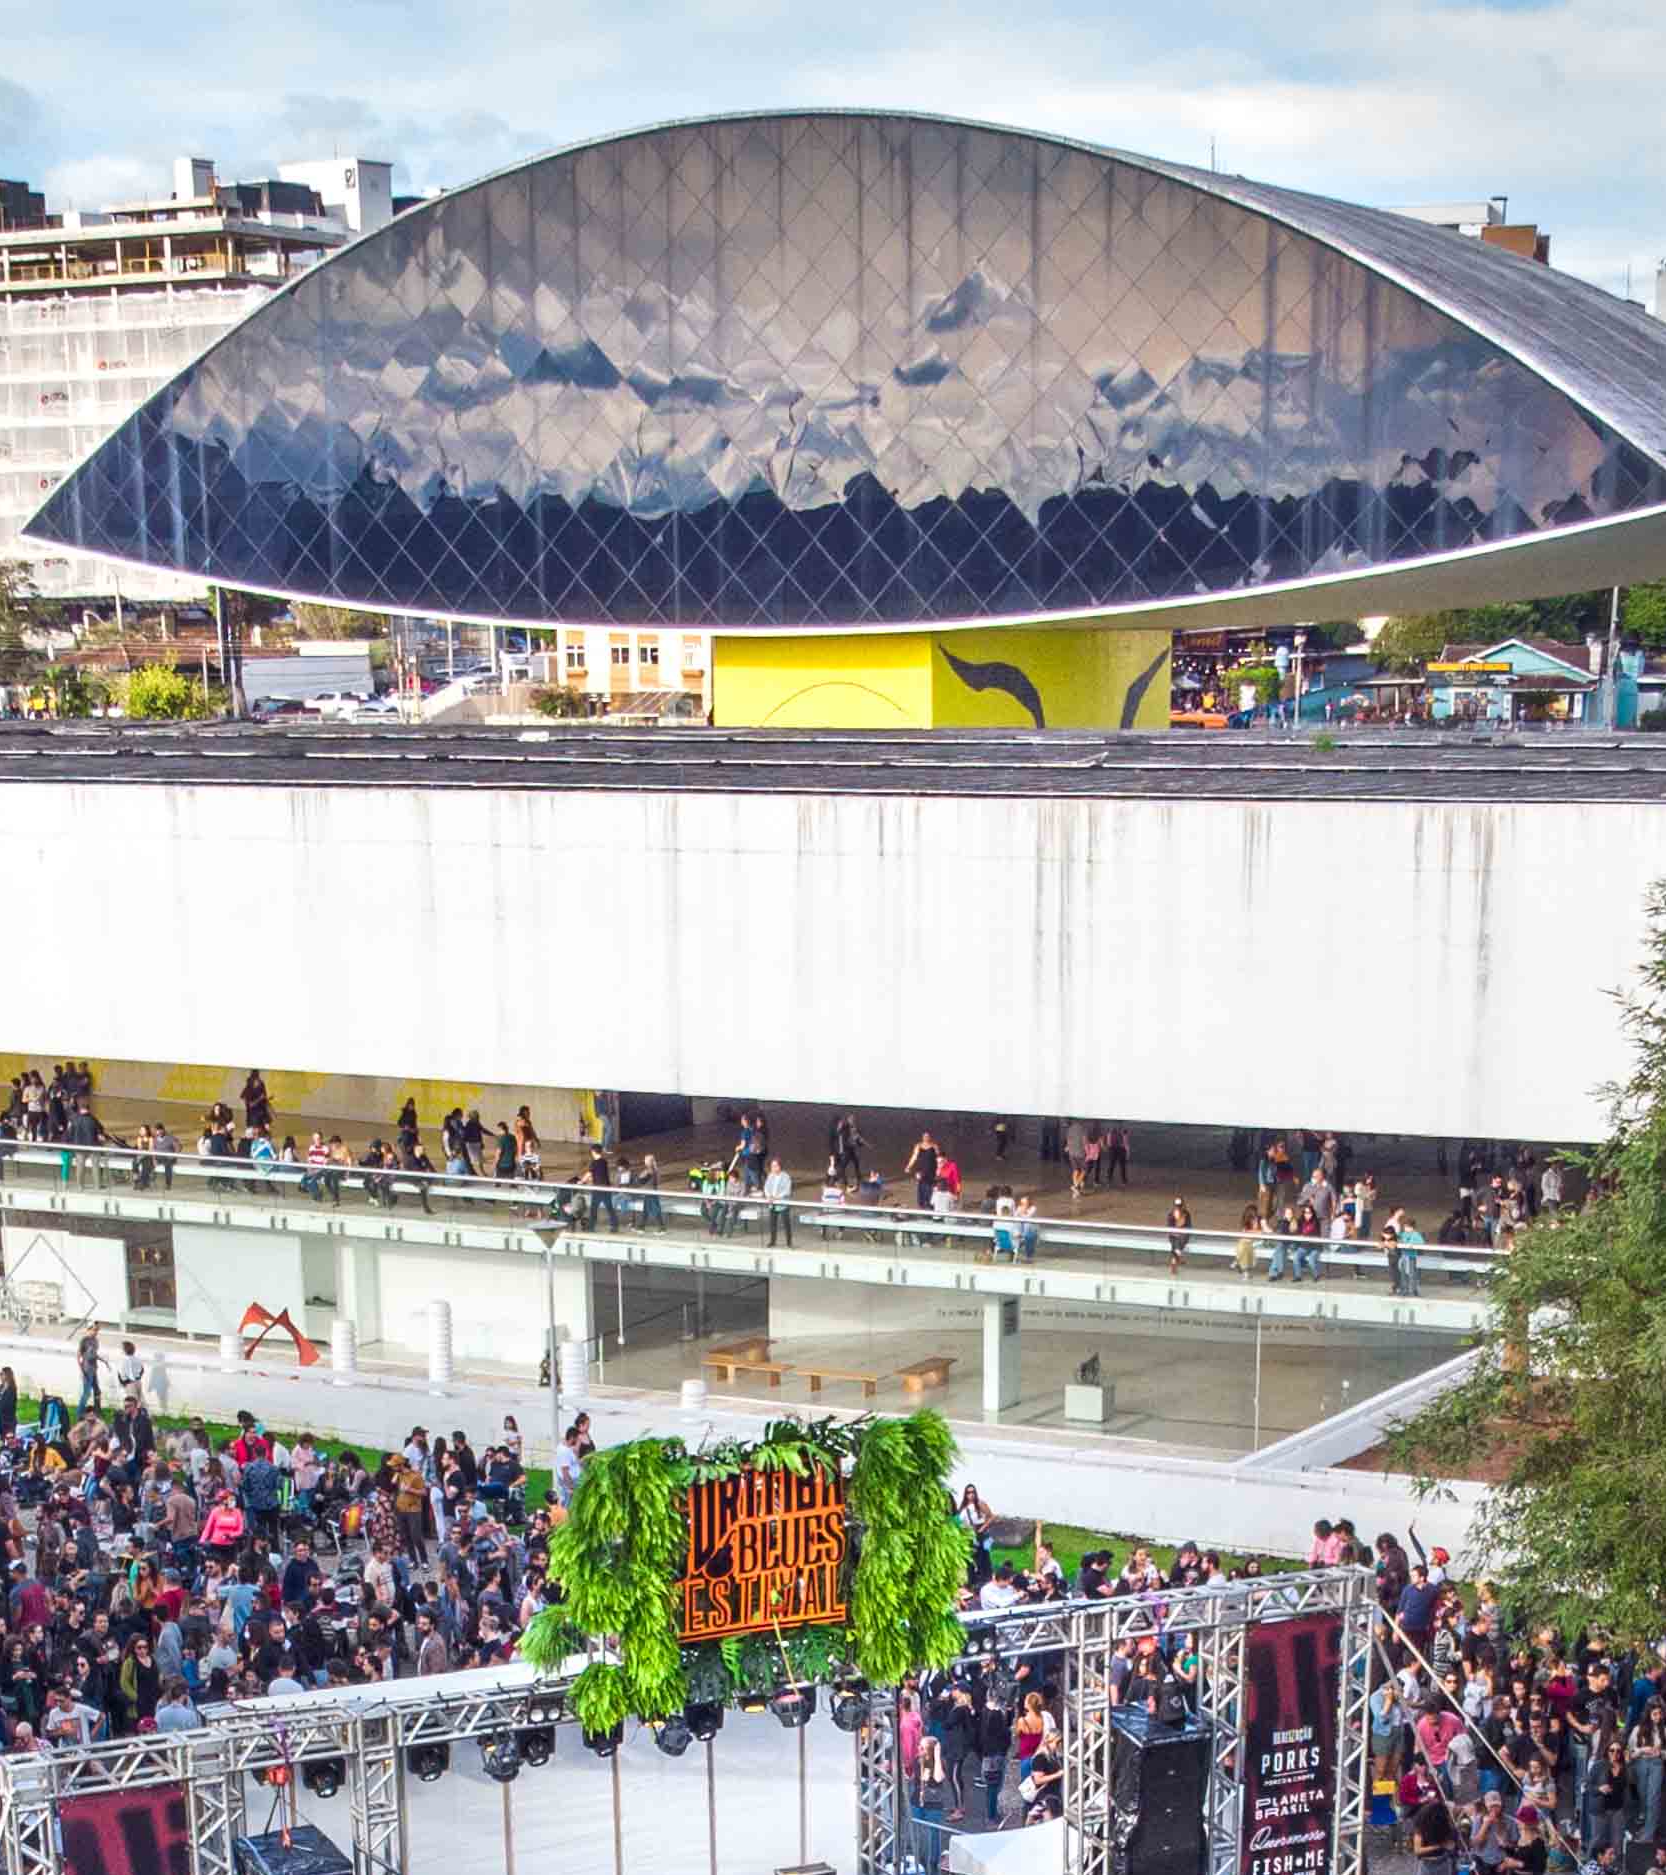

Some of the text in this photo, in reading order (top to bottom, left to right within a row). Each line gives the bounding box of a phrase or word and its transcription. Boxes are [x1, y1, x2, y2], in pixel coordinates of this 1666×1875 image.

[738, 1511, 845, 1575] BLUES
[683, 1565, 846, 1632] ESTIVAL
[1261, 1747, 1320, 1775] PORKS
[1255, 1789, 1325, 1809] PLANETA
[1255, 1804, 1310, 1820] BRASIL
